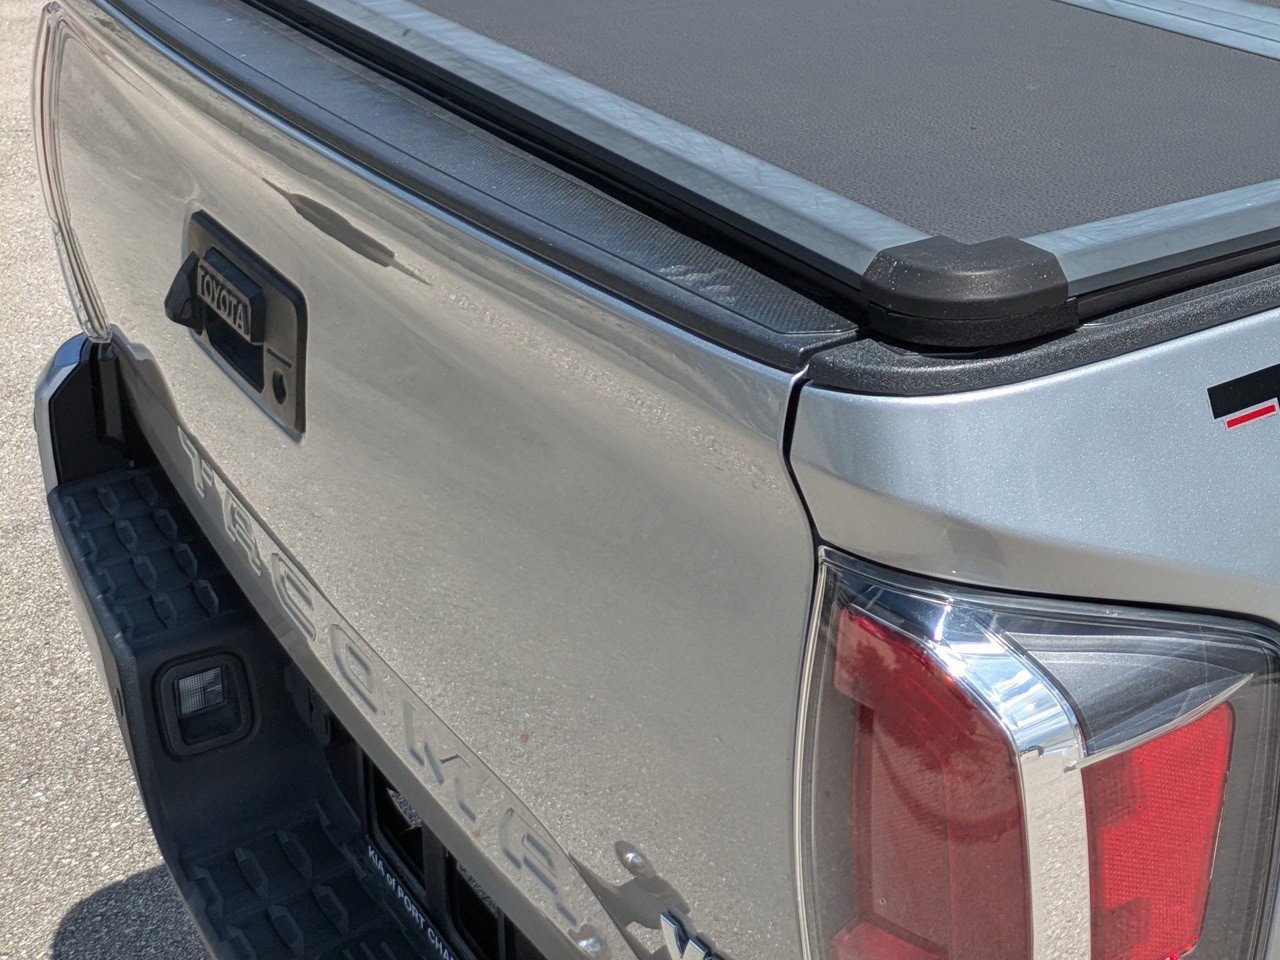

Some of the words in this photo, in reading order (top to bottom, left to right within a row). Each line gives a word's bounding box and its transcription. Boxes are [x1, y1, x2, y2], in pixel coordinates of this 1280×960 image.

[199, 265, 251, 336] TOYOTA
[367, 844, 386, 876] KIA
[397, 884, 426, 930] PORT
[427, 926, 455, 960] CHA
